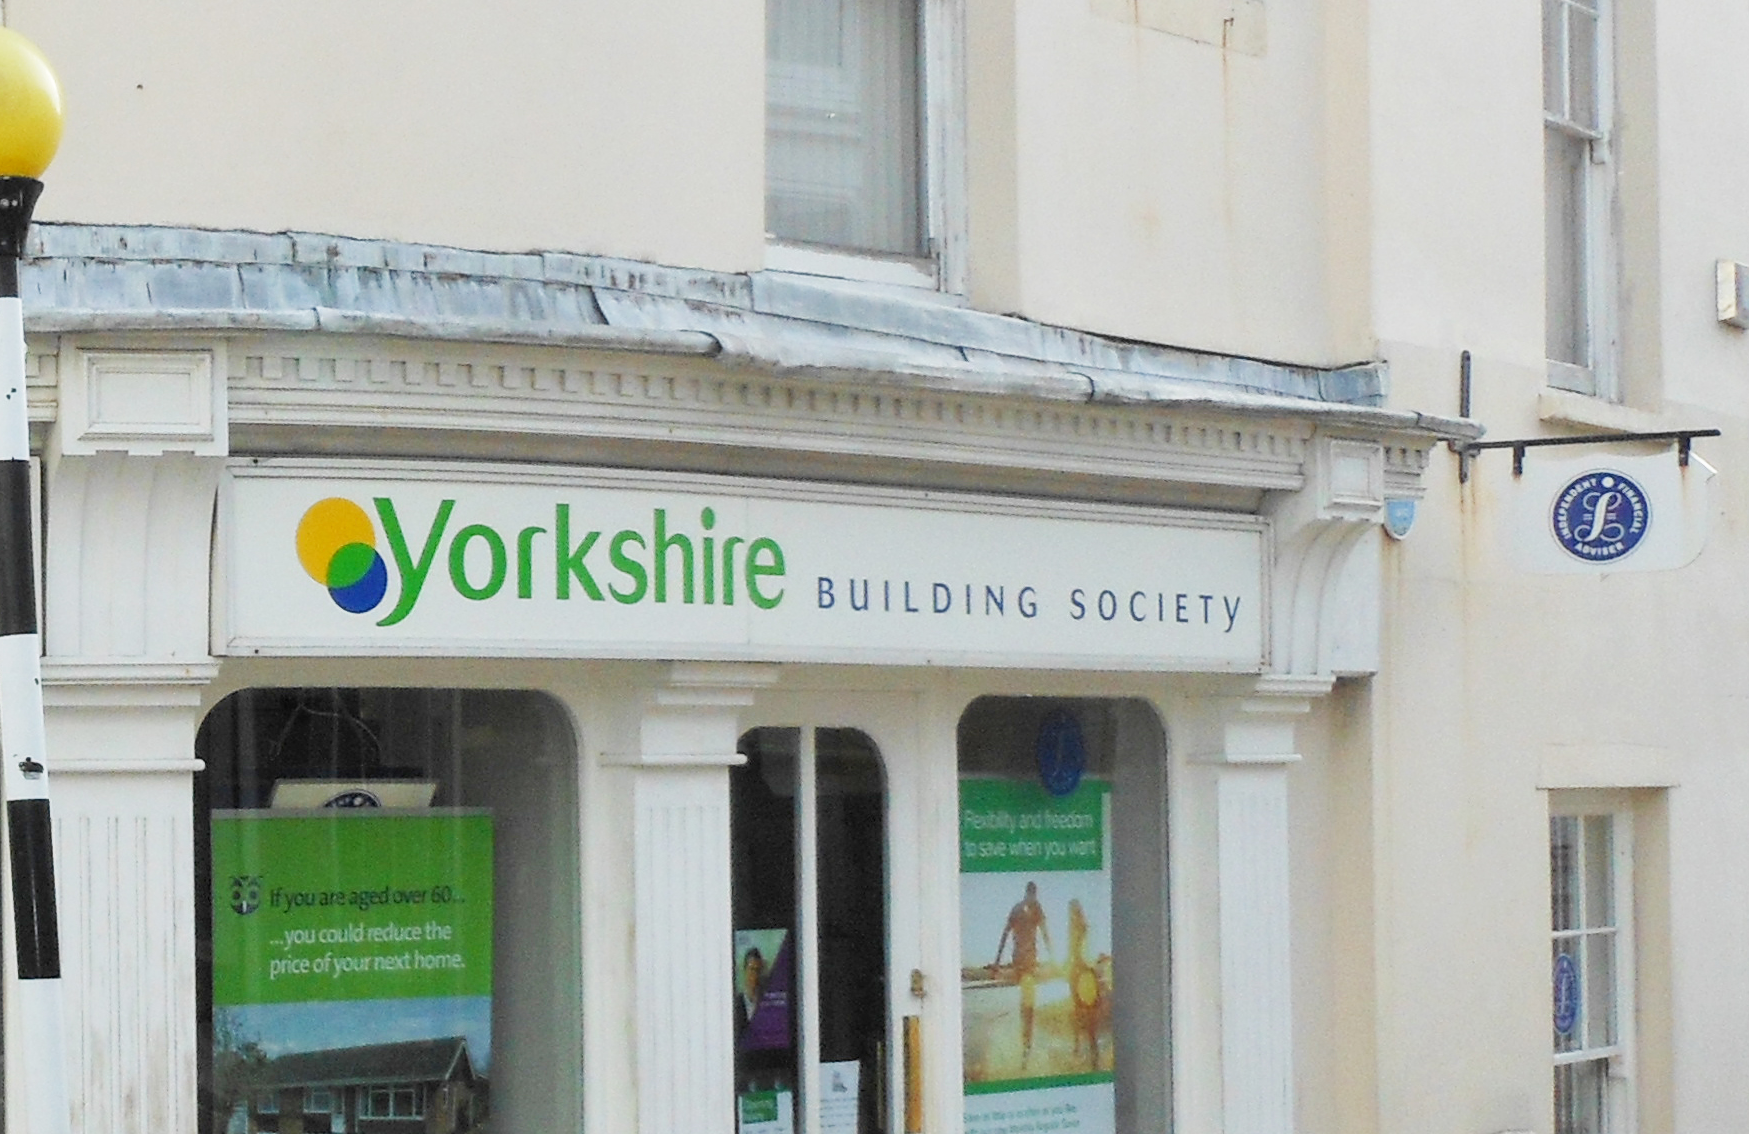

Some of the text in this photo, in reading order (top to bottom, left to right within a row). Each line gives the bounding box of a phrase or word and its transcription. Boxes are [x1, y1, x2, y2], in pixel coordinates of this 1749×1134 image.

[1557, 478, 1597, 540] INDEPENDENT
[1617, 482, 1644, 534] FINANCIAL
[1574, 541, 1625, 556] ADVISER
[817, 577, 1039, 619] BUILDING
[1069, 588, 1241, 632] SOCIETY
[283, 892, 316, 914] you
[319, 892, 346, 906] are
[349, 886, 390, 911] aged
[392, 890, 427, 905] over
[318, 921, 365, 944] could
[367, 920, 422, 942] reduce
[424, 920, 452, 941] the
[269, 949, 466, 981] price of your next home.
